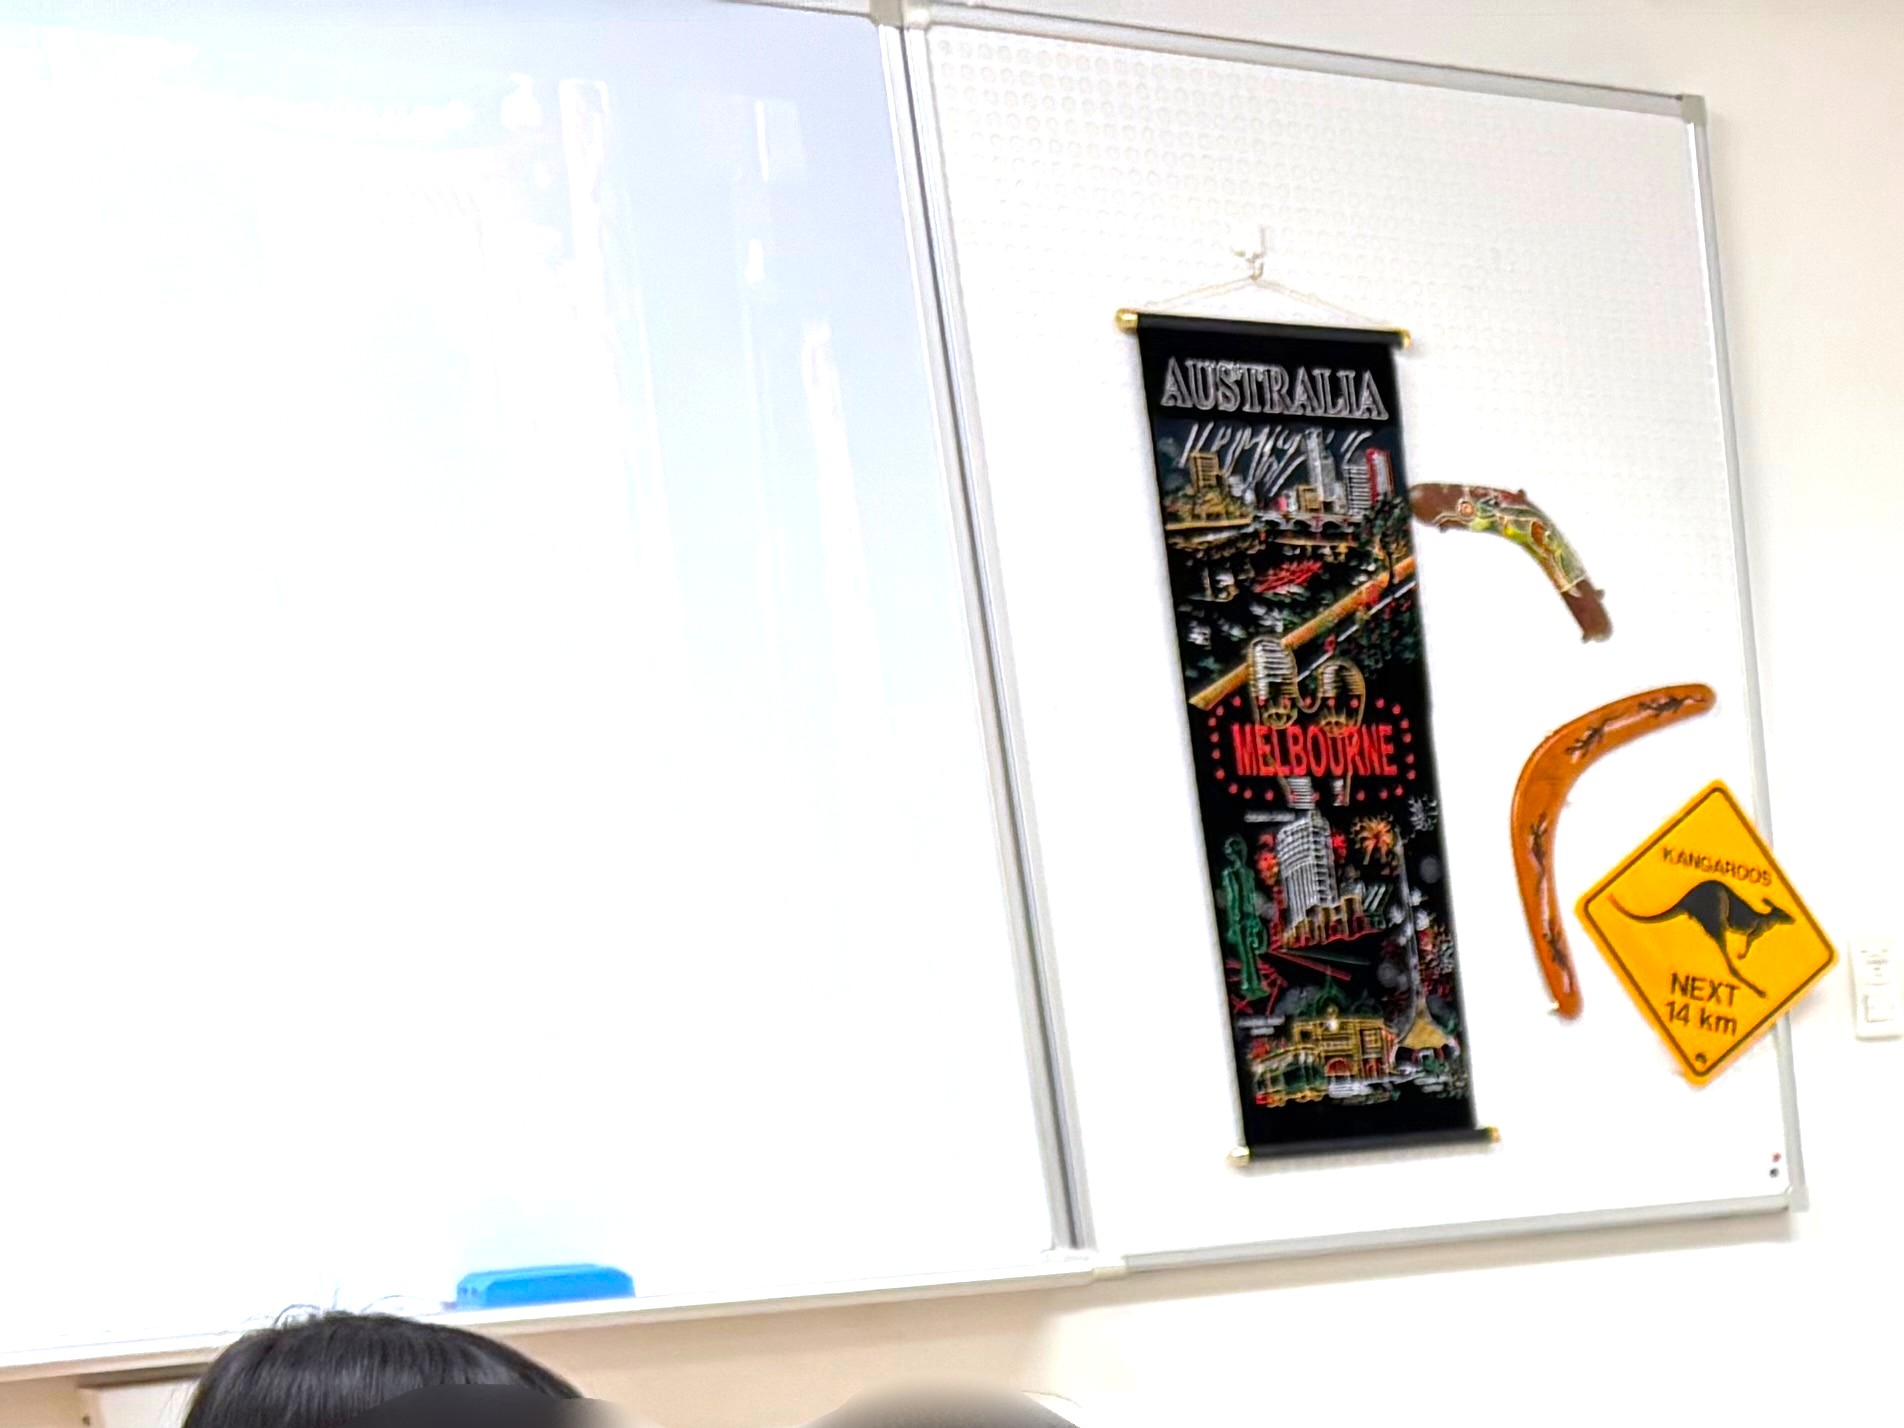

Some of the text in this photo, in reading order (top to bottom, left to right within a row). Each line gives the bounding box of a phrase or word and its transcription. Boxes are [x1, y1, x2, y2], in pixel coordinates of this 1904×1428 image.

[1160, 356, 1389, 420] AUSTRALIA
[1232, 722, 1398, 777] MELBOURNE
[1662, 847, 1773, 887] KANGAROOS
[1670, 972, 1741, 1008] NEXT
[1665, 1001, 1738, 1037] 14 km
